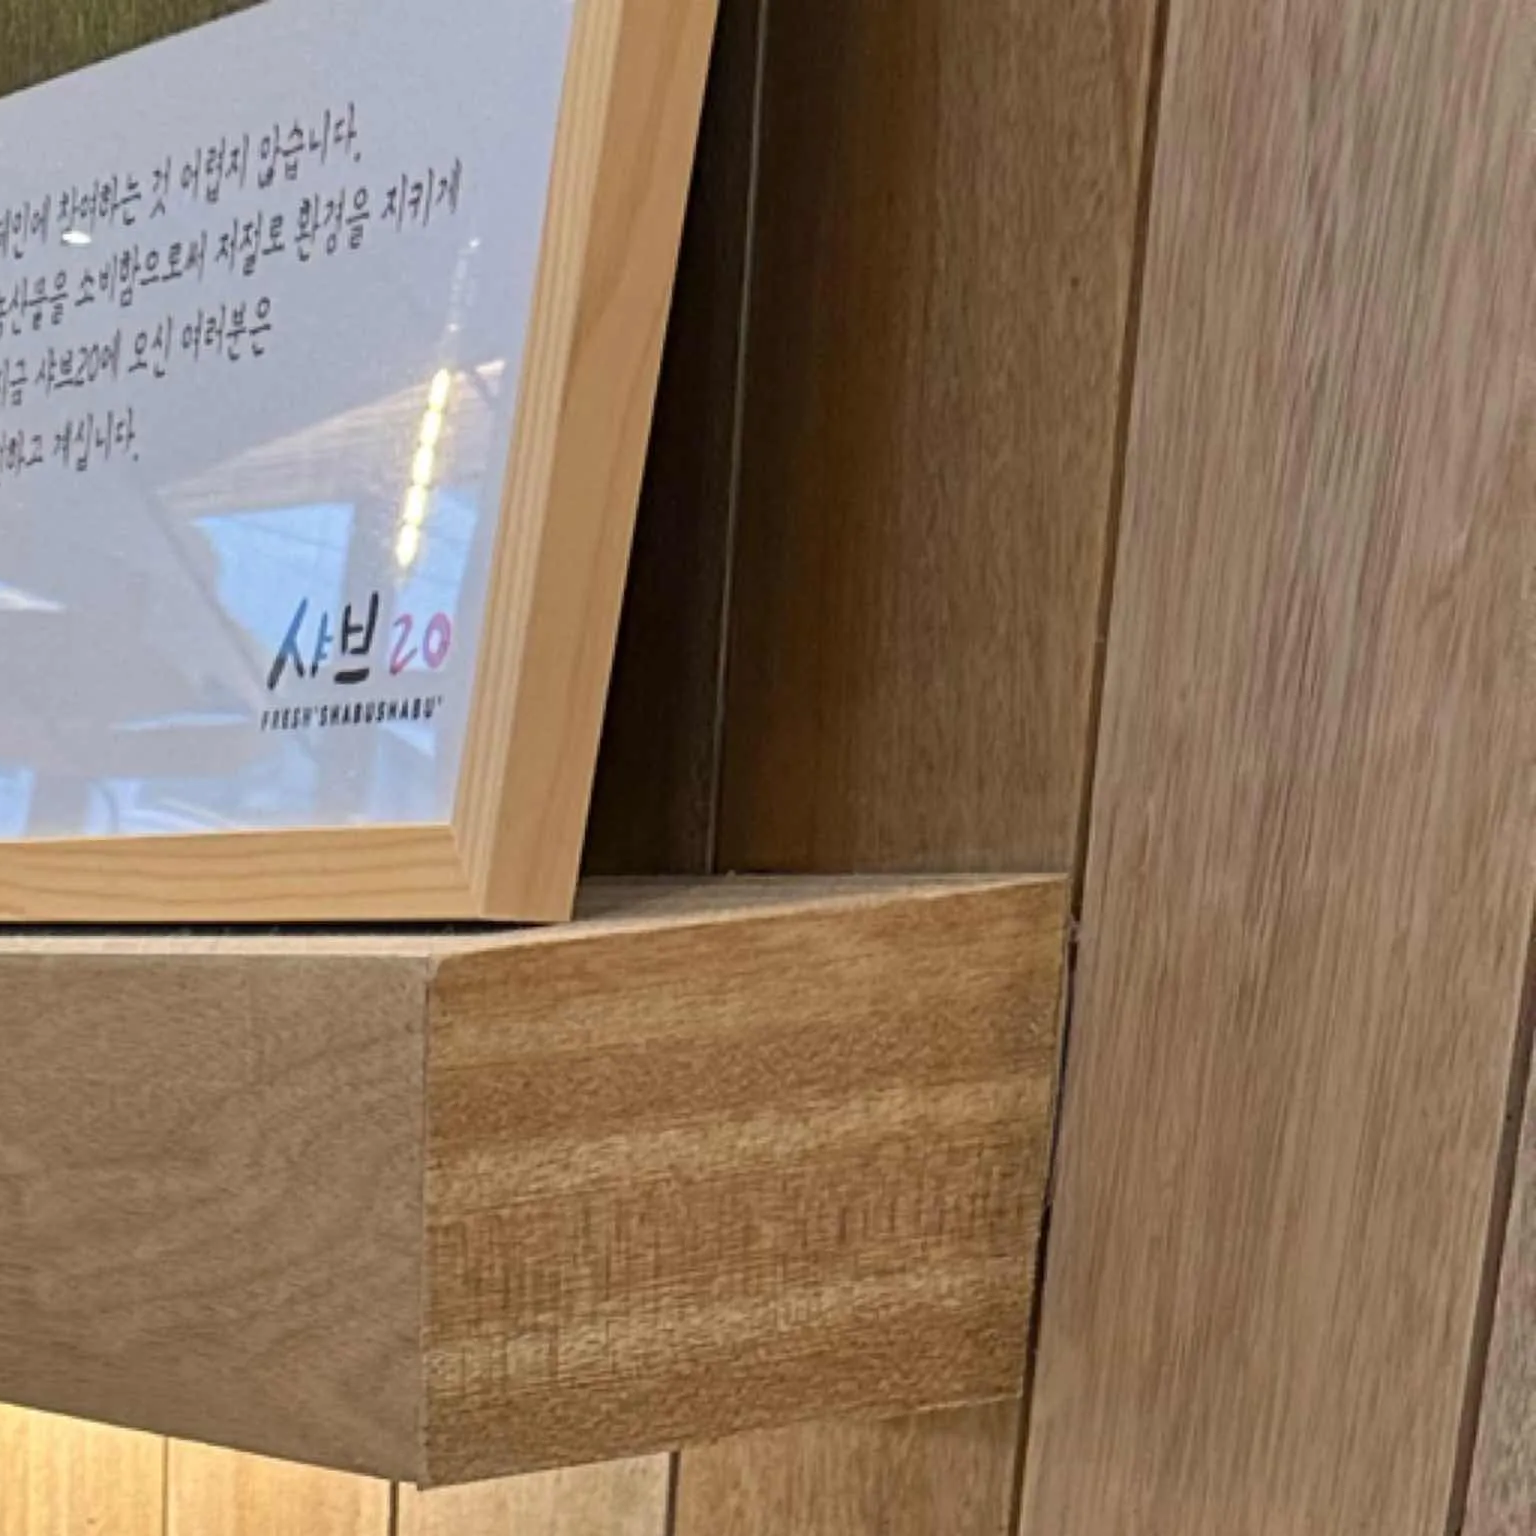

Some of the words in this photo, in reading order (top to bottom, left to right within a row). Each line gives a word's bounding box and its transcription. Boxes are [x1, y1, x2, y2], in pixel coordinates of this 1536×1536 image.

[150, 155, 171, 219] 것
[180, 132, 250, 204] 어렵지
[258, 101, 361, 190] 않습니다.
[74, 230, 207, 308] 소비함으로써
[214, 210, 285, 277] 저절로
[294, 187, 370, 263] 환경을
[381, 156, 463, 233] 지키게
[35, 328, 121, 398] 샤브20에
[128, 315, 173, 379] 오신
[181, 296, 272, 360] 여러분은
[53, 406, 140, 472] 계십니다.
